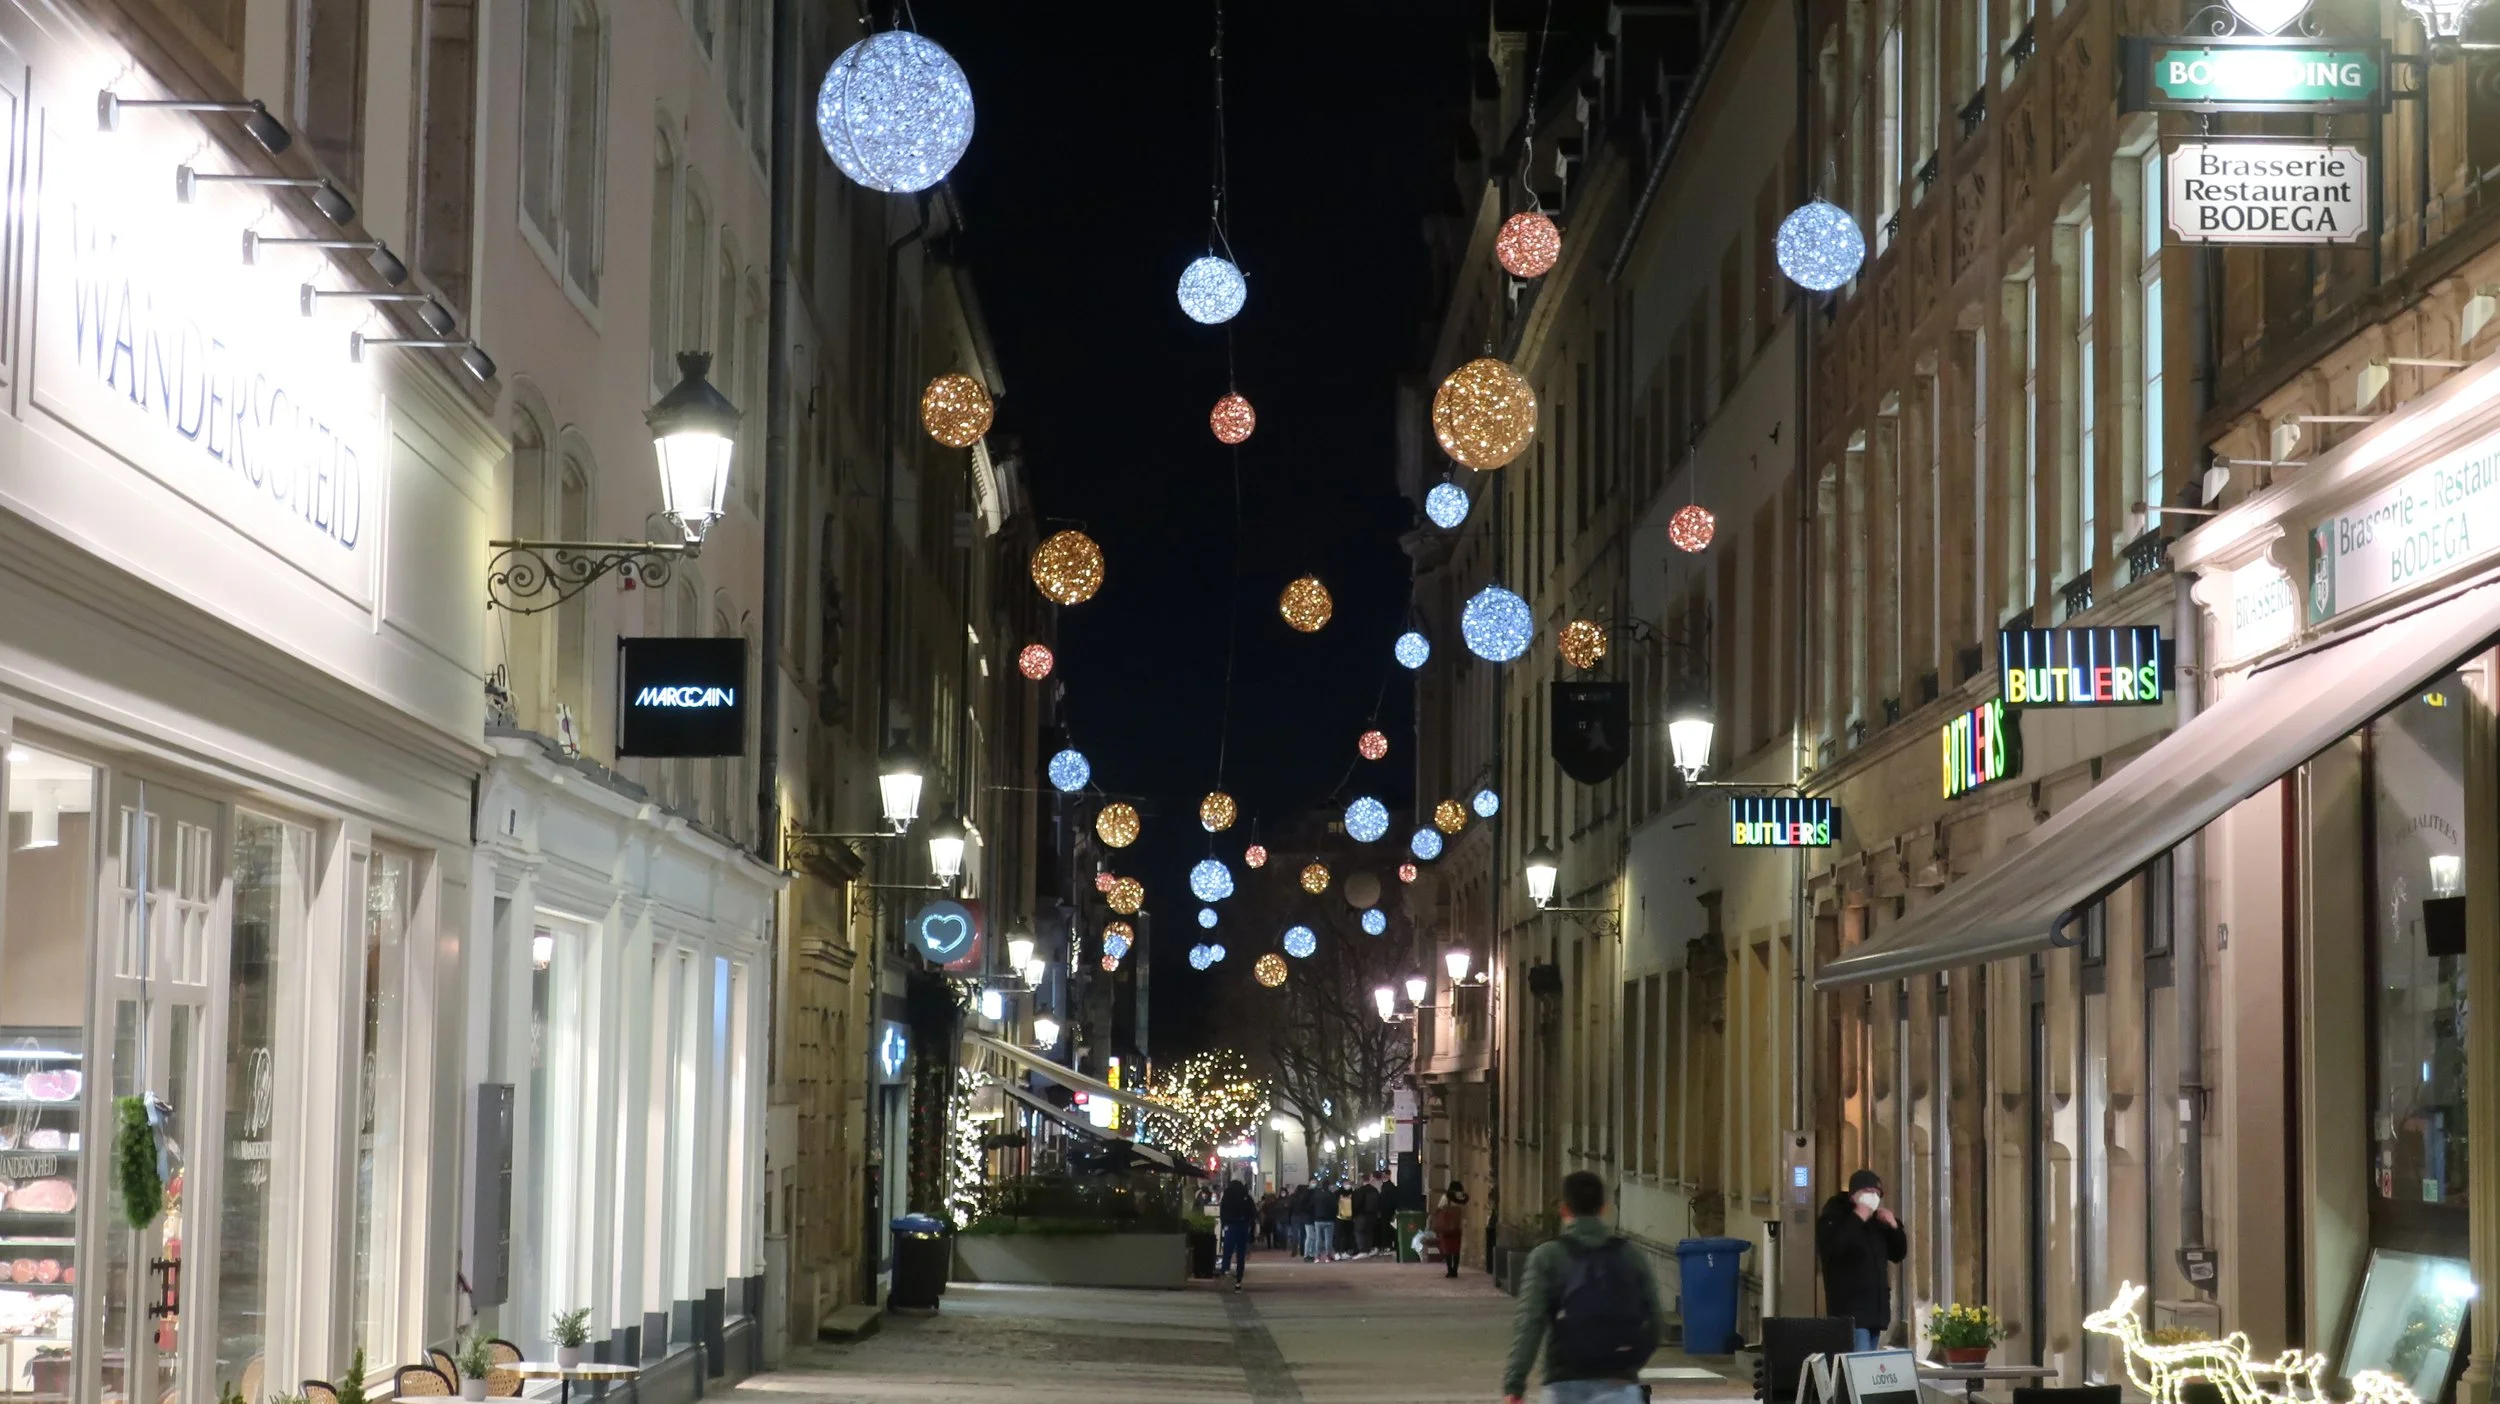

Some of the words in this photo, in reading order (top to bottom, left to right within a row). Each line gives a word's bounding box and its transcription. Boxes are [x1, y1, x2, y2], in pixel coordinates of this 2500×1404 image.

[2168, 61, 2362, 87] BODING
[2199, 153, 2346, 178] Brasserie
[2184, 178, 2352, 203] Restaurant
[2199, 205, 2339, 232] BODEGA
[2391, 511, 2471, 584] BODEGA
[2008, 664, 2158, 703] BUTLERS
[1941, 698, 2005, 800] BUTLERS
[1735, 821, 1828, 845] BUTLERS
[0, 1153, 58, 1179] ANDERSCHEID
